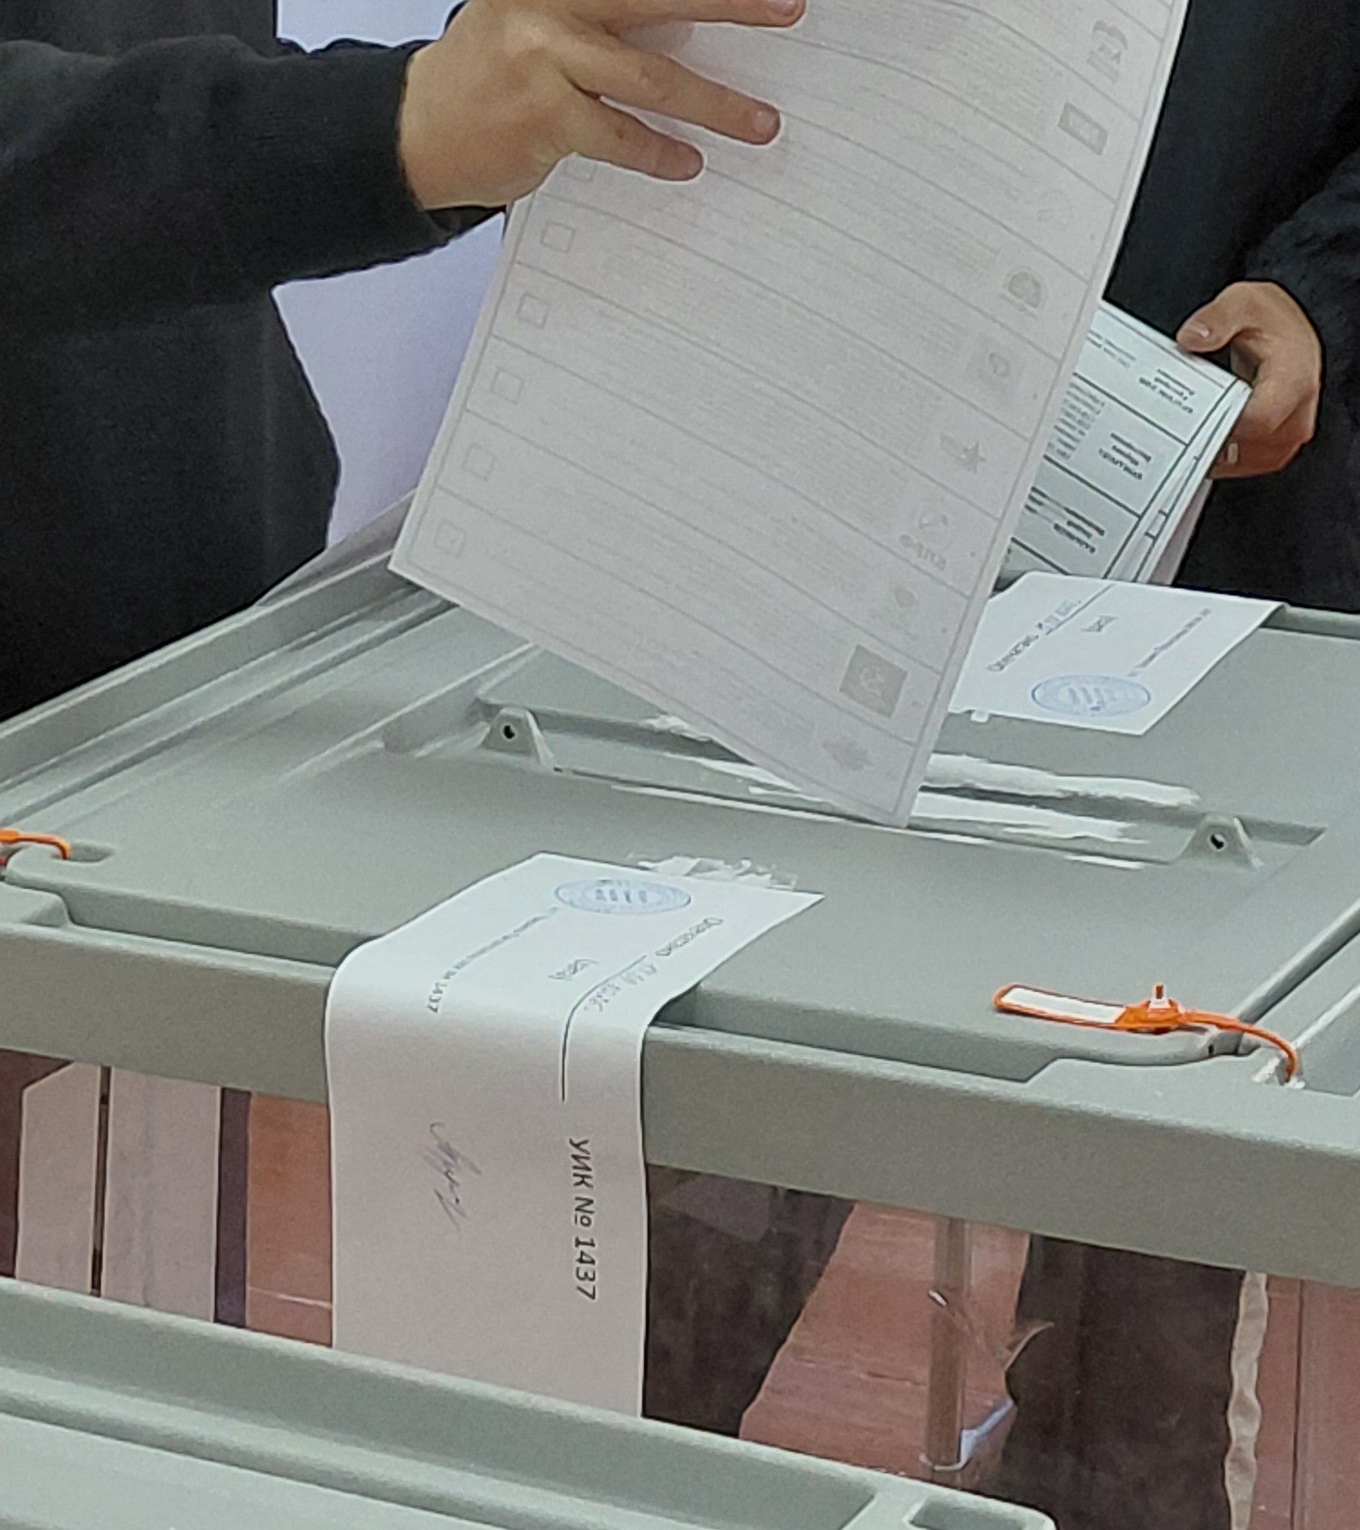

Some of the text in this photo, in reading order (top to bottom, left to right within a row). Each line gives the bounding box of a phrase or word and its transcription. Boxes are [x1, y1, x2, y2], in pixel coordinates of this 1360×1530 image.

[568, 1137, 597, 1301] УИК № 1437
